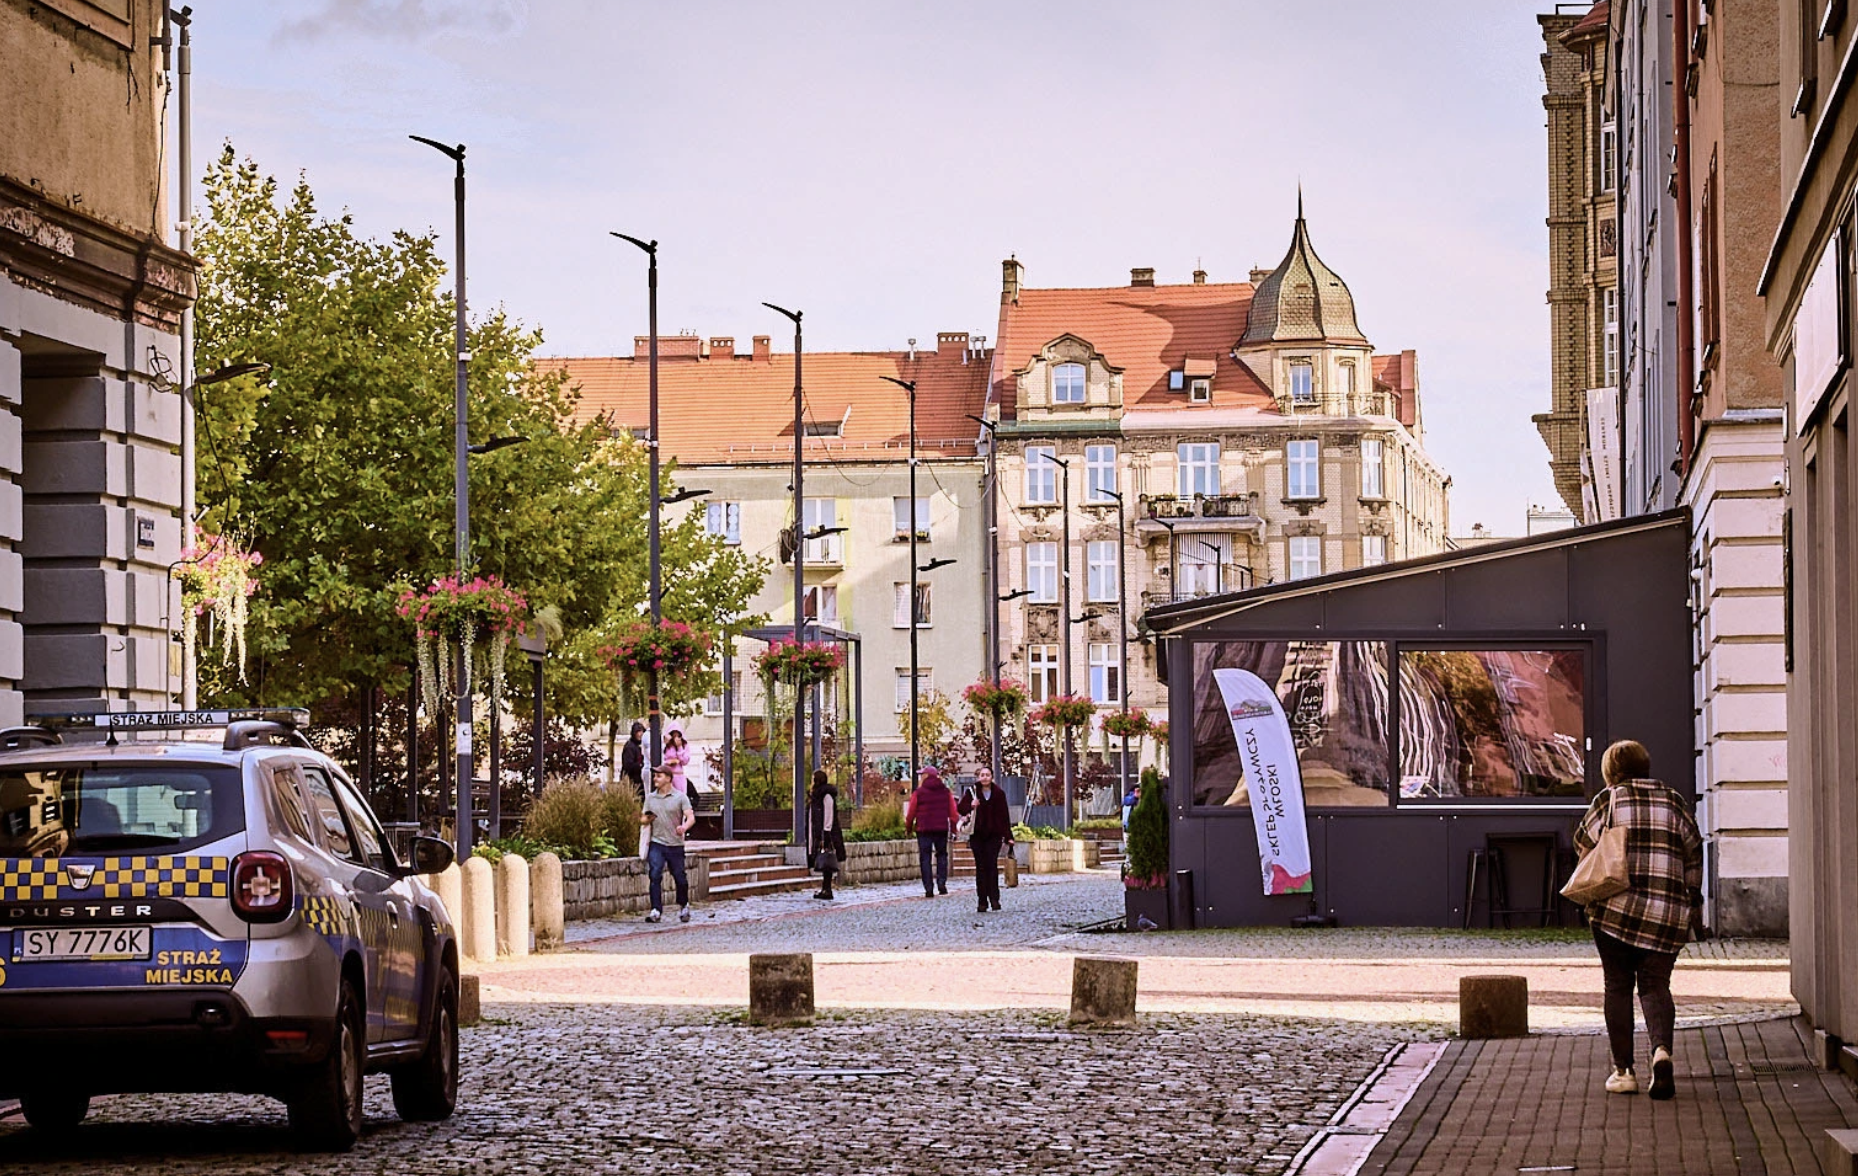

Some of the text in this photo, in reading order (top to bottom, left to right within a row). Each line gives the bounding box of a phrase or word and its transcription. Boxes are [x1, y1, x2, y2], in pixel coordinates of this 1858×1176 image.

[157, 713, 213, 725] MIEJSKA
[9, 905, 152, 918] DUSTER
[29, 929, 143, 955] SY 7776K
[157, 948, 221, 965] STRAŻ
[146, 968, 233, 984] MIEJSKA
